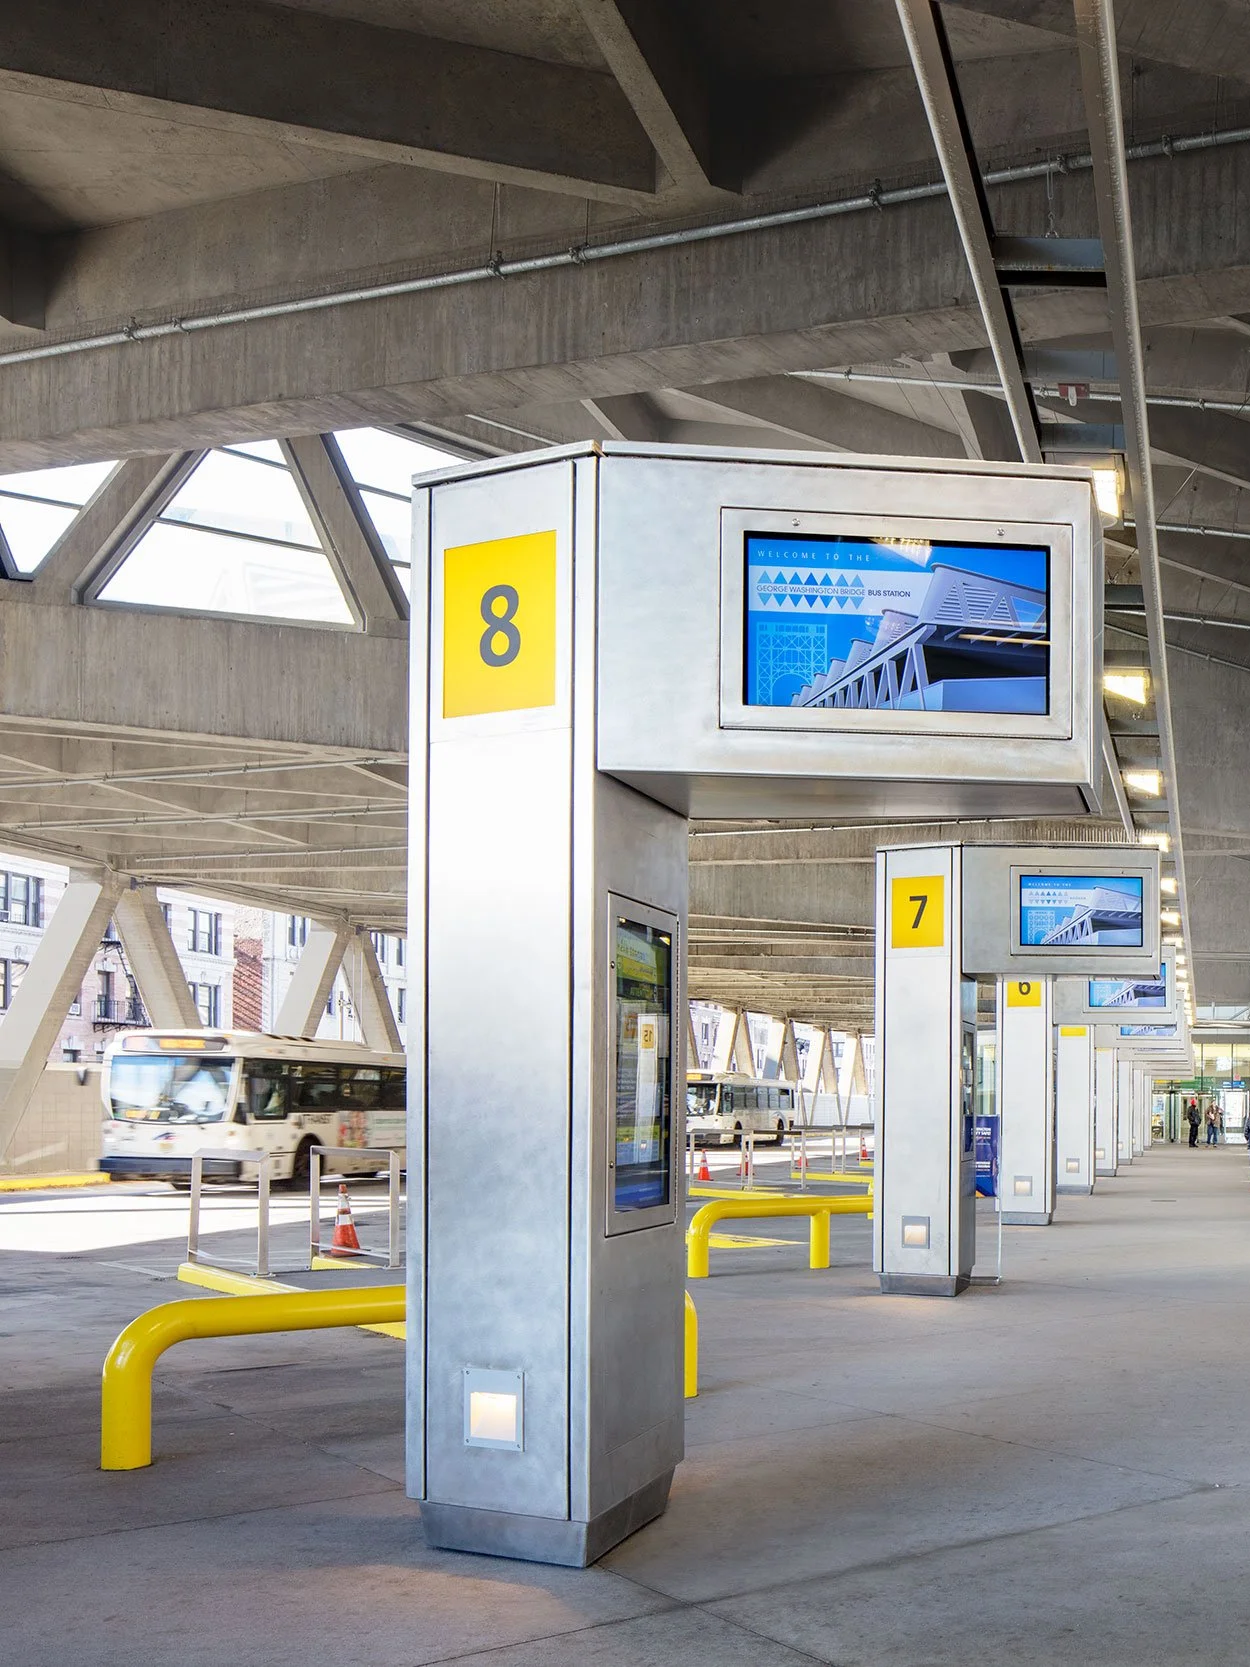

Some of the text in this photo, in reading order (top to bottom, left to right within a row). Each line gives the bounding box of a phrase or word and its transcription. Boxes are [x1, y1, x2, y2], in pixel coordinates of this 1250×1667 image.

[758, 550, 816, 560] WELCOME
[849, 553, 870, 562] THE
[756, 585, 911, 598] GEORGE WASHINGTON BRIDGE BUS STATION
[479, 584, 521, 667] 8
[909, 895, 928, 929] 7
